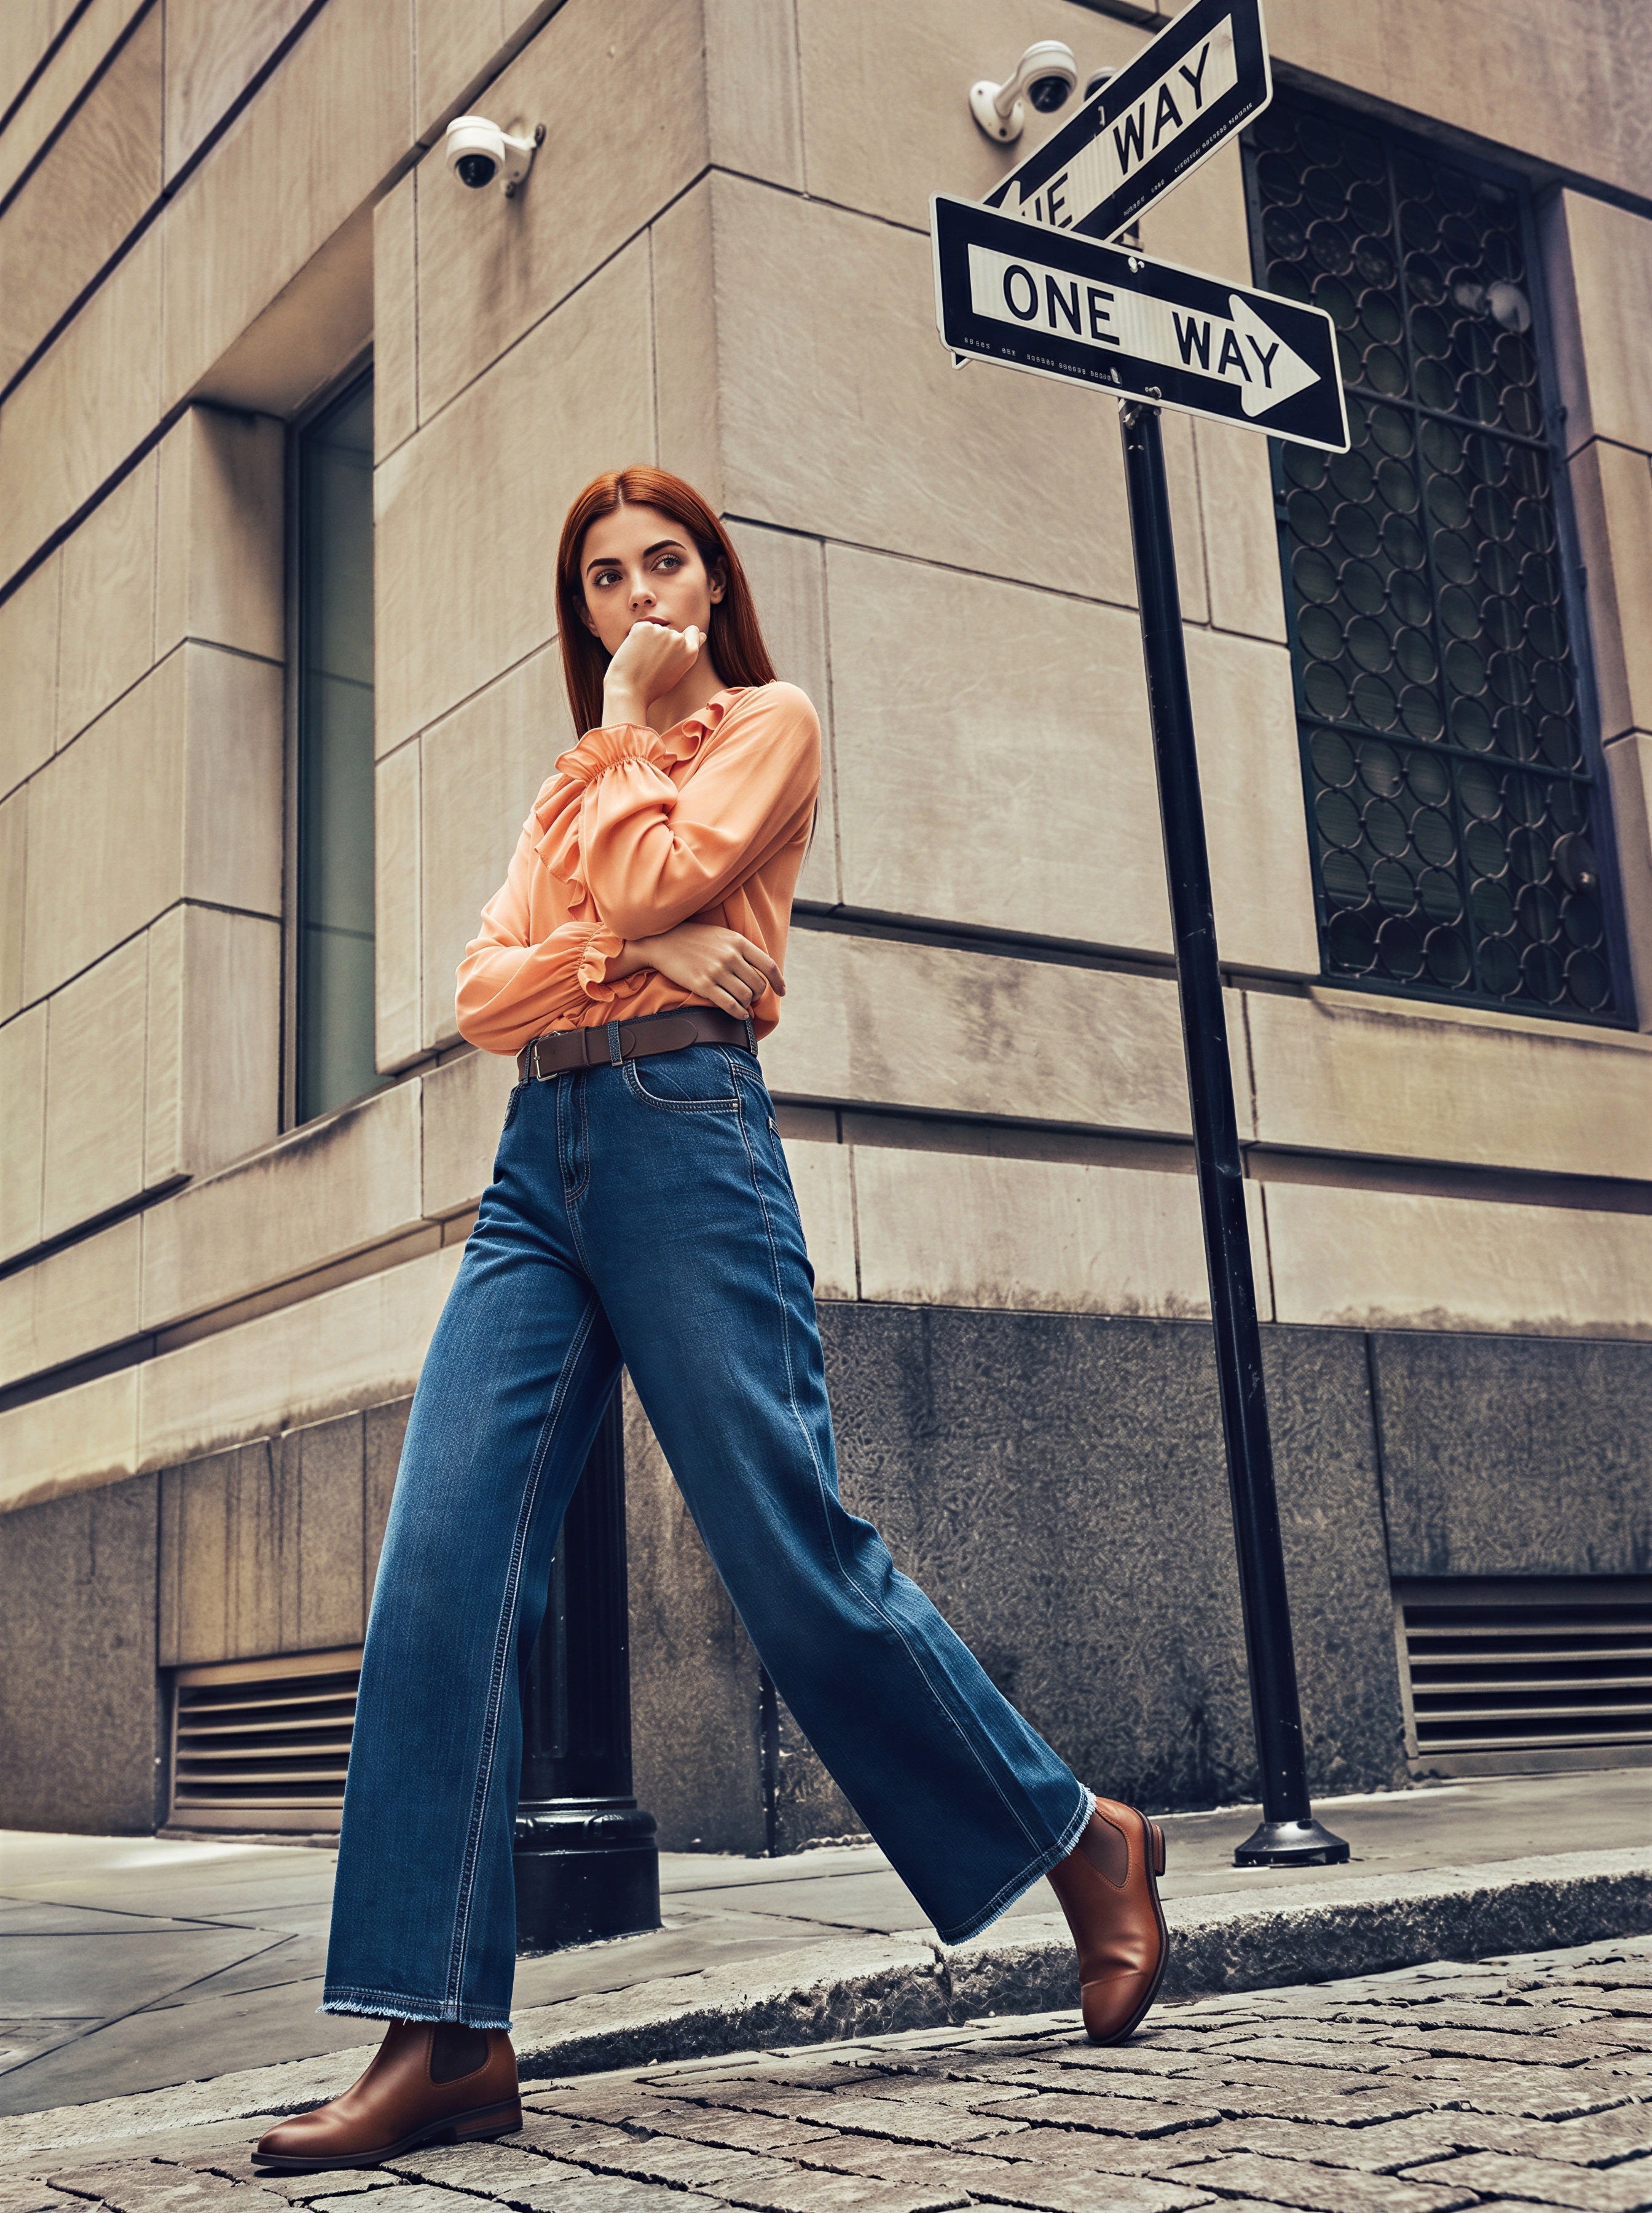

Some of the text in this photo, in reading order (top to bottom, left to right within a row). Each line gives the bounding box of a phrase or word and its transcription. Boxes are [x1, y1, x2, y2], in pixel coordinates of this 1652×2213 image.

[1112, 42, 1210, 176] WAY
[1003, 264, 1120, 345] ONE
[1172, 311, 1280, 389] WAY
